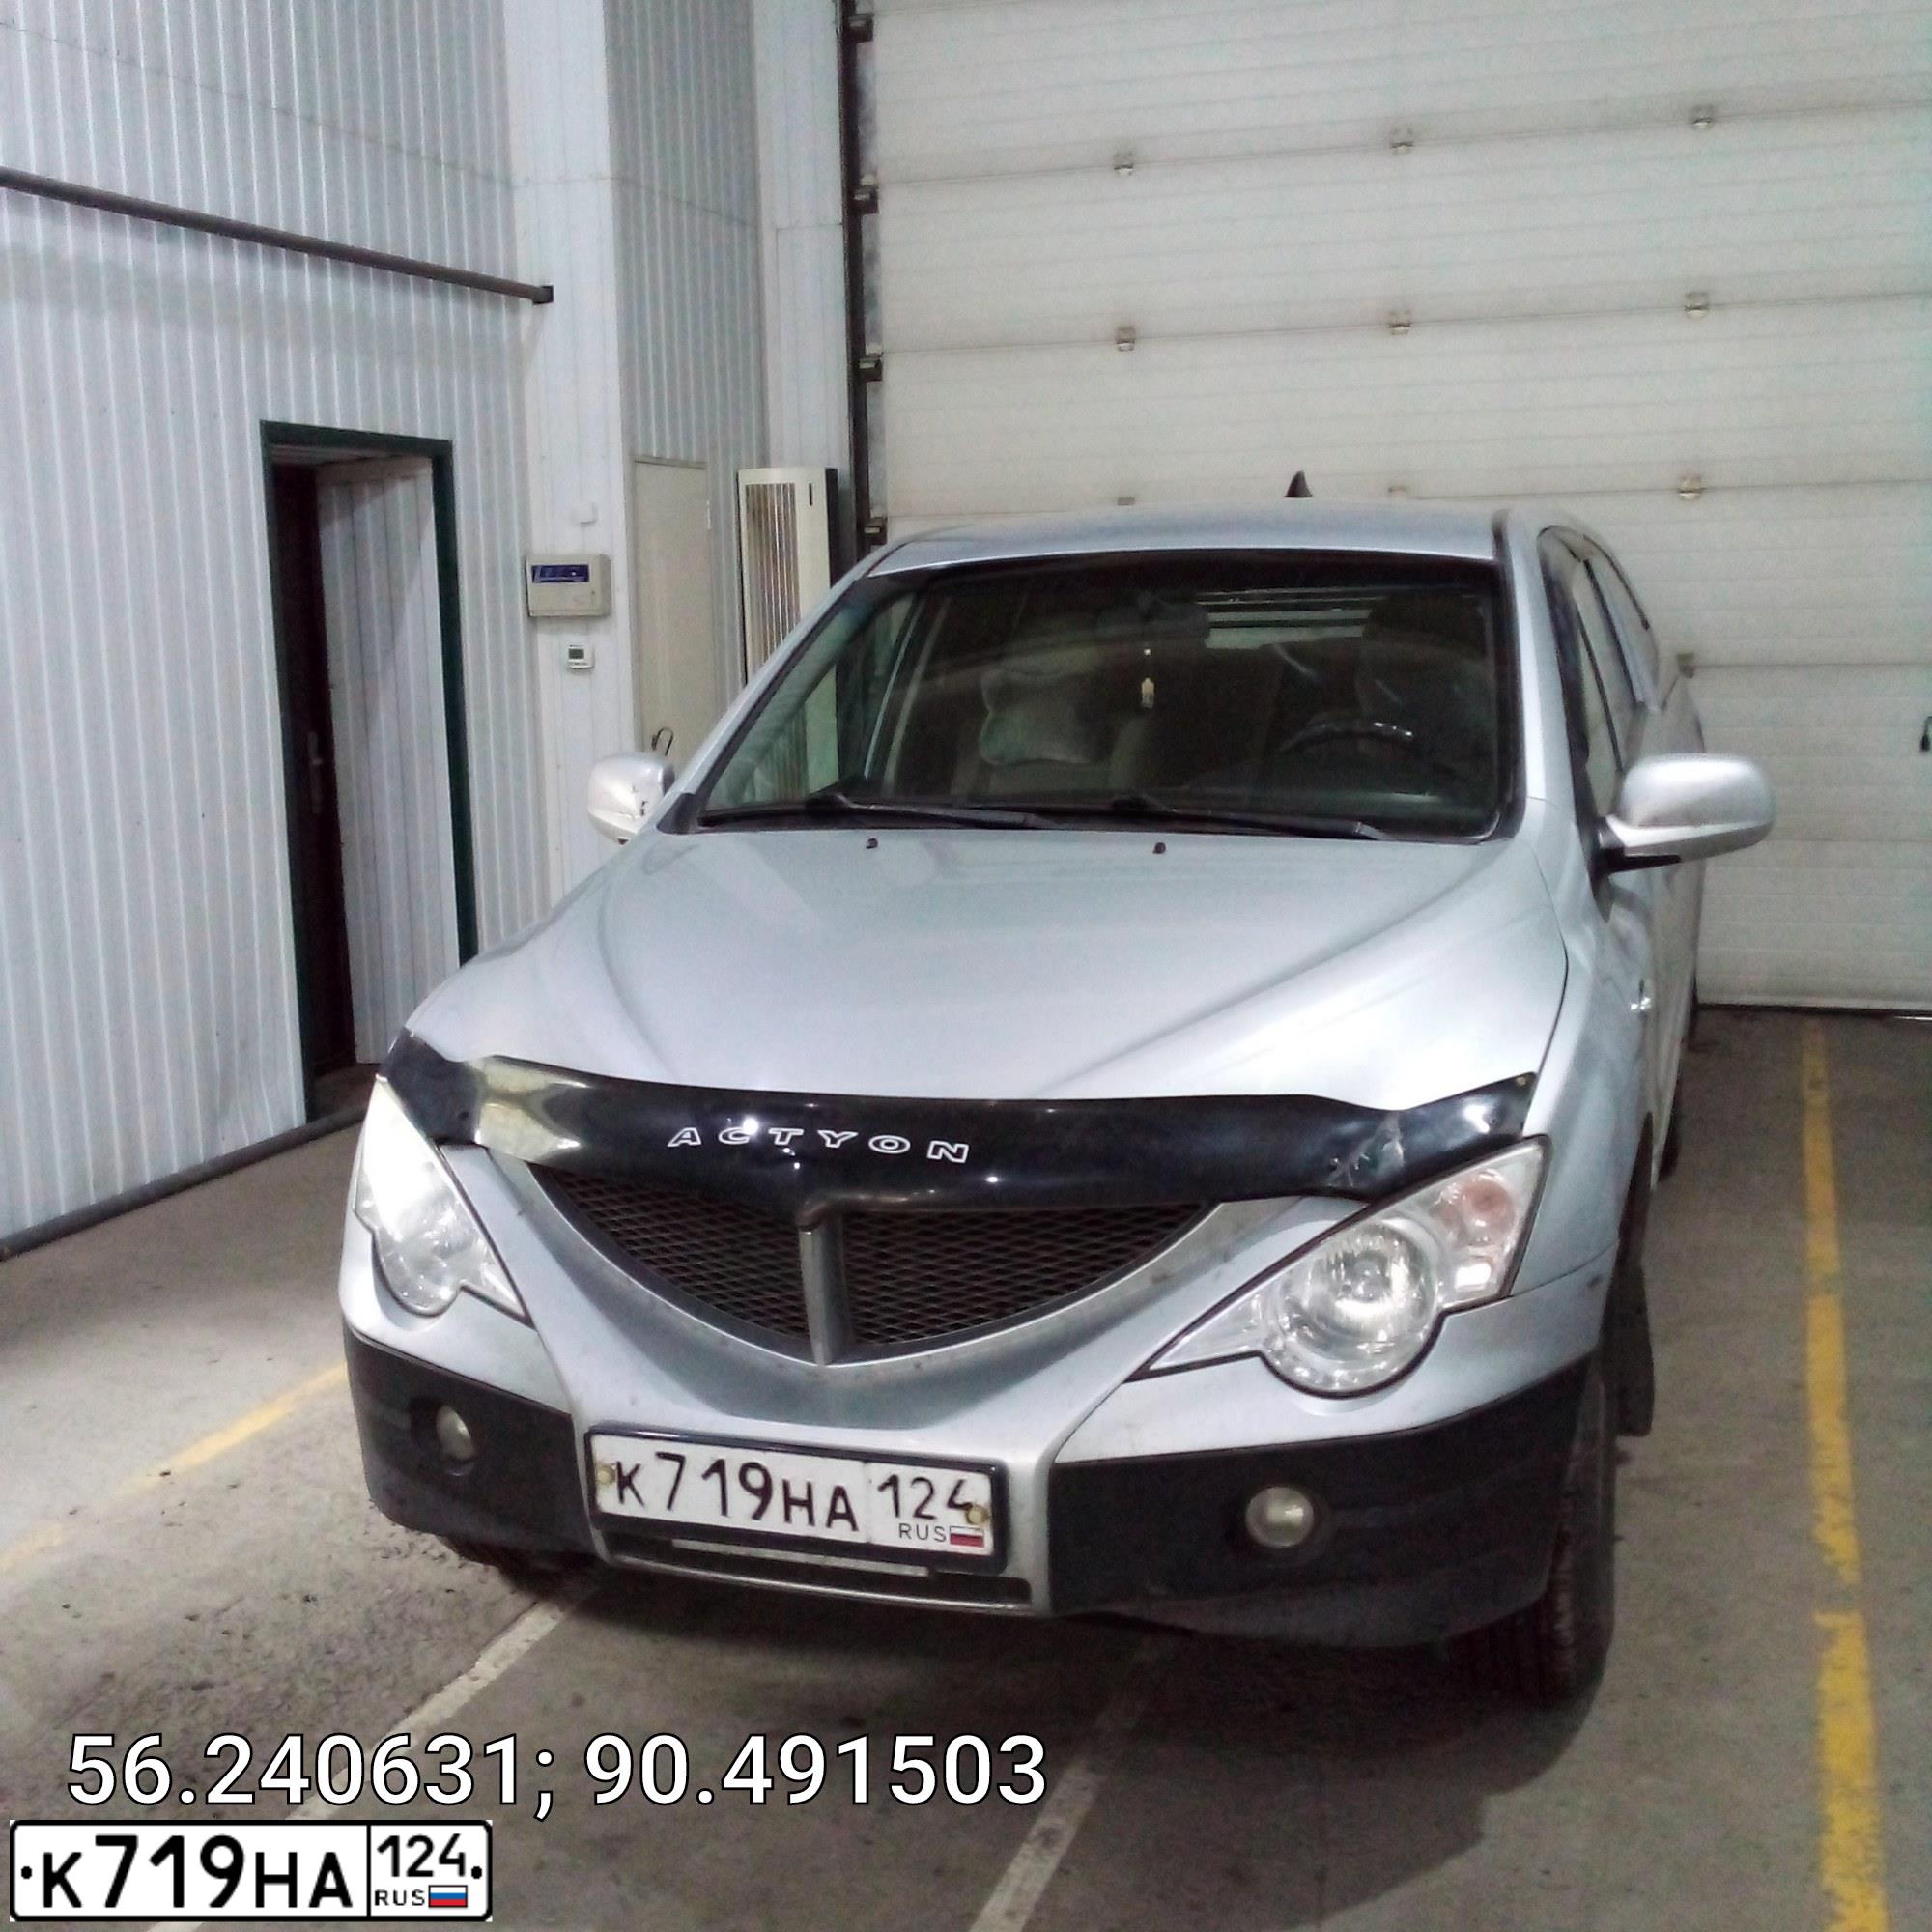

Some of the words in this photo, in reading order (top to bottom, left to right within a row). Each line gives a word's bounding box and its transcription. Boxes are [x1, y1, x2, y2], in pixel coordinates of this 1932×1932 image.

[667, 1126, 970, 1164] ACTYON
[877, 1473, 980, 1520] 124
[898, 1522, 947, 1544] RUS
